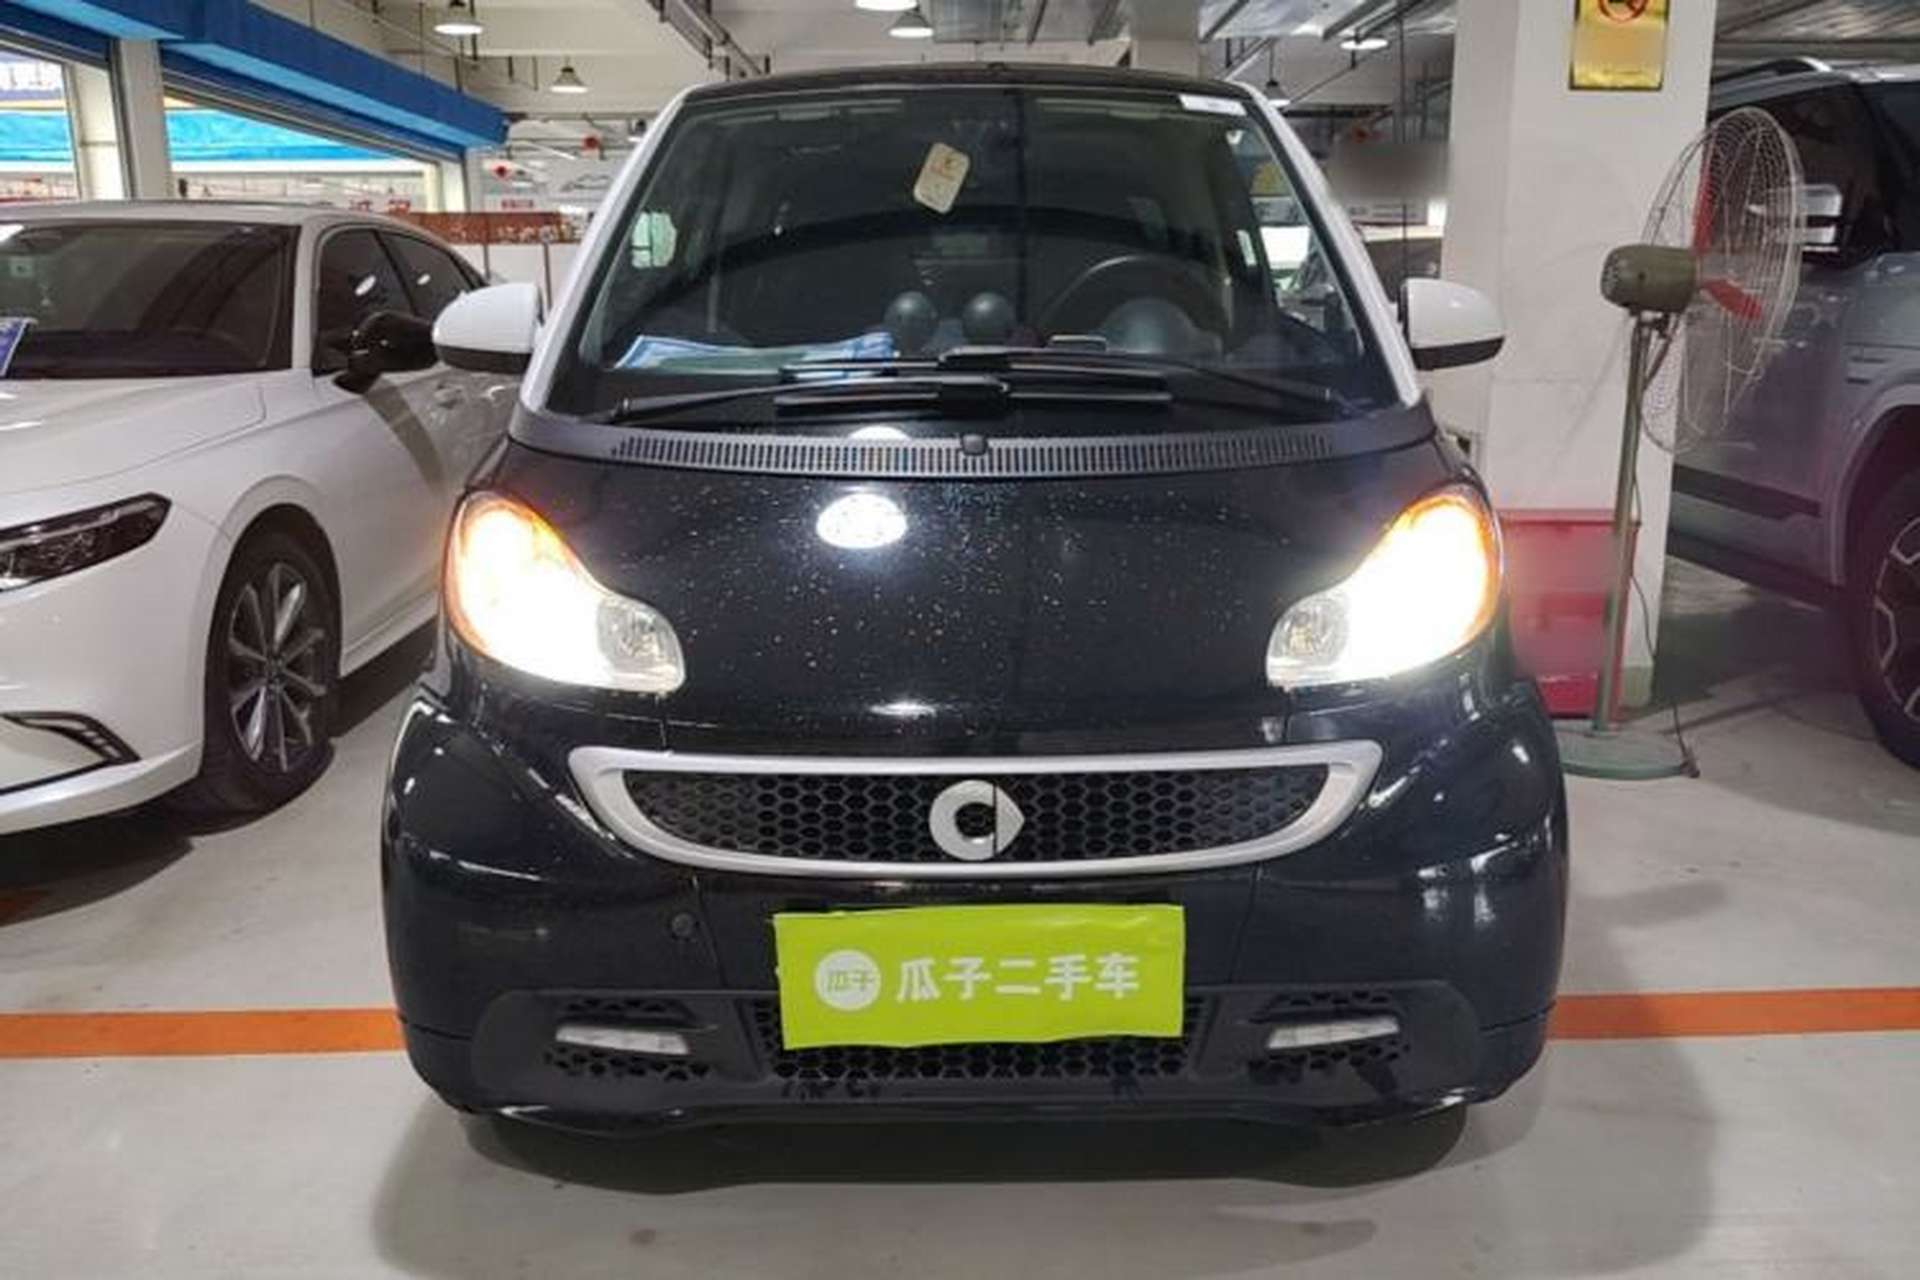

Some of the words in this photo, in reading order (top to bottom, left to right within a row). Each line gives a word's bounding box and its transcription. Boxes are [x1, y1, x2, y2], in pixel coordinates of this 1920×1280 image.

[897, 952, 1140, 1003] 瓜子二手车
